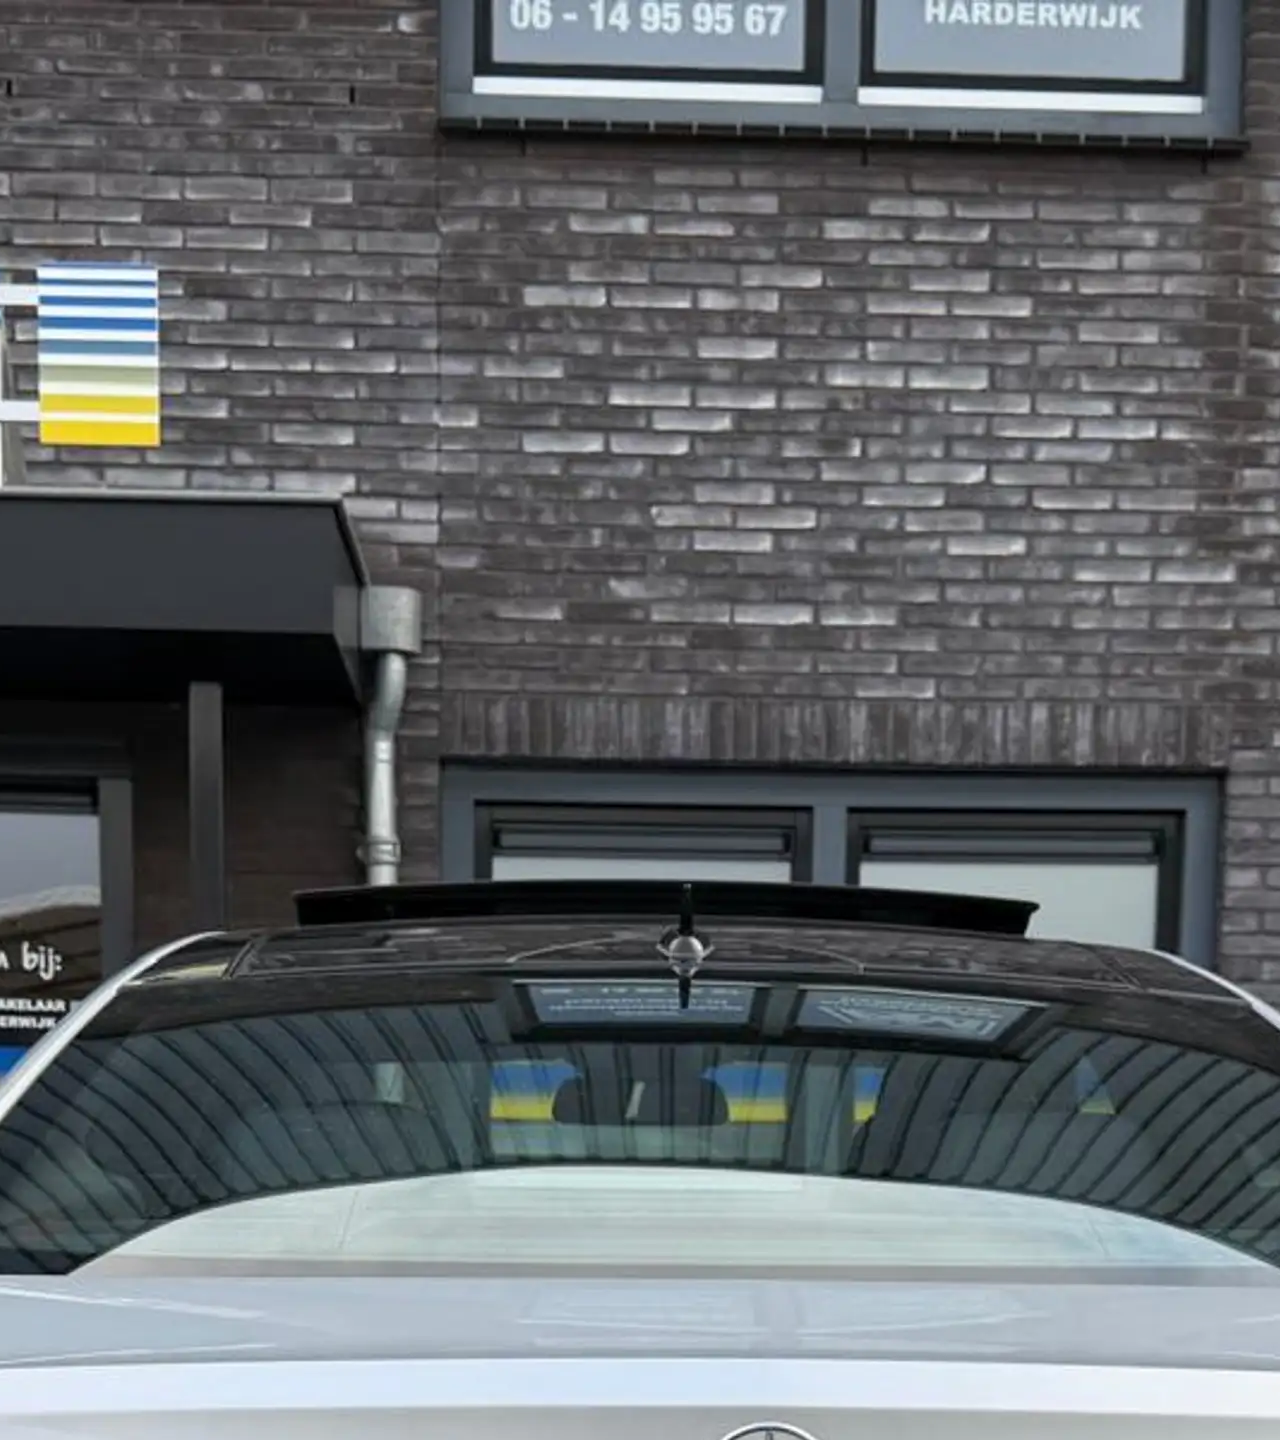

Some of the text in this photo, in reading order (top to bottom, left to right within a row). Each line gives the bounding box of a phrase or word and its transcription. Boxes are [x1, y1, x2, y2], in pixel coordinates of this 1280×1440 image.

[510, 0, 553, 30] 06
[589, 0, 631, 32] 14
[640, 2, 681, 34] 95
[692, 3, 734, 35] 95
[744, 4, 787, 36] 67
[925, 0, 1142, 29] HARDERWIJK
[21, 941, 62, 980] bij:
